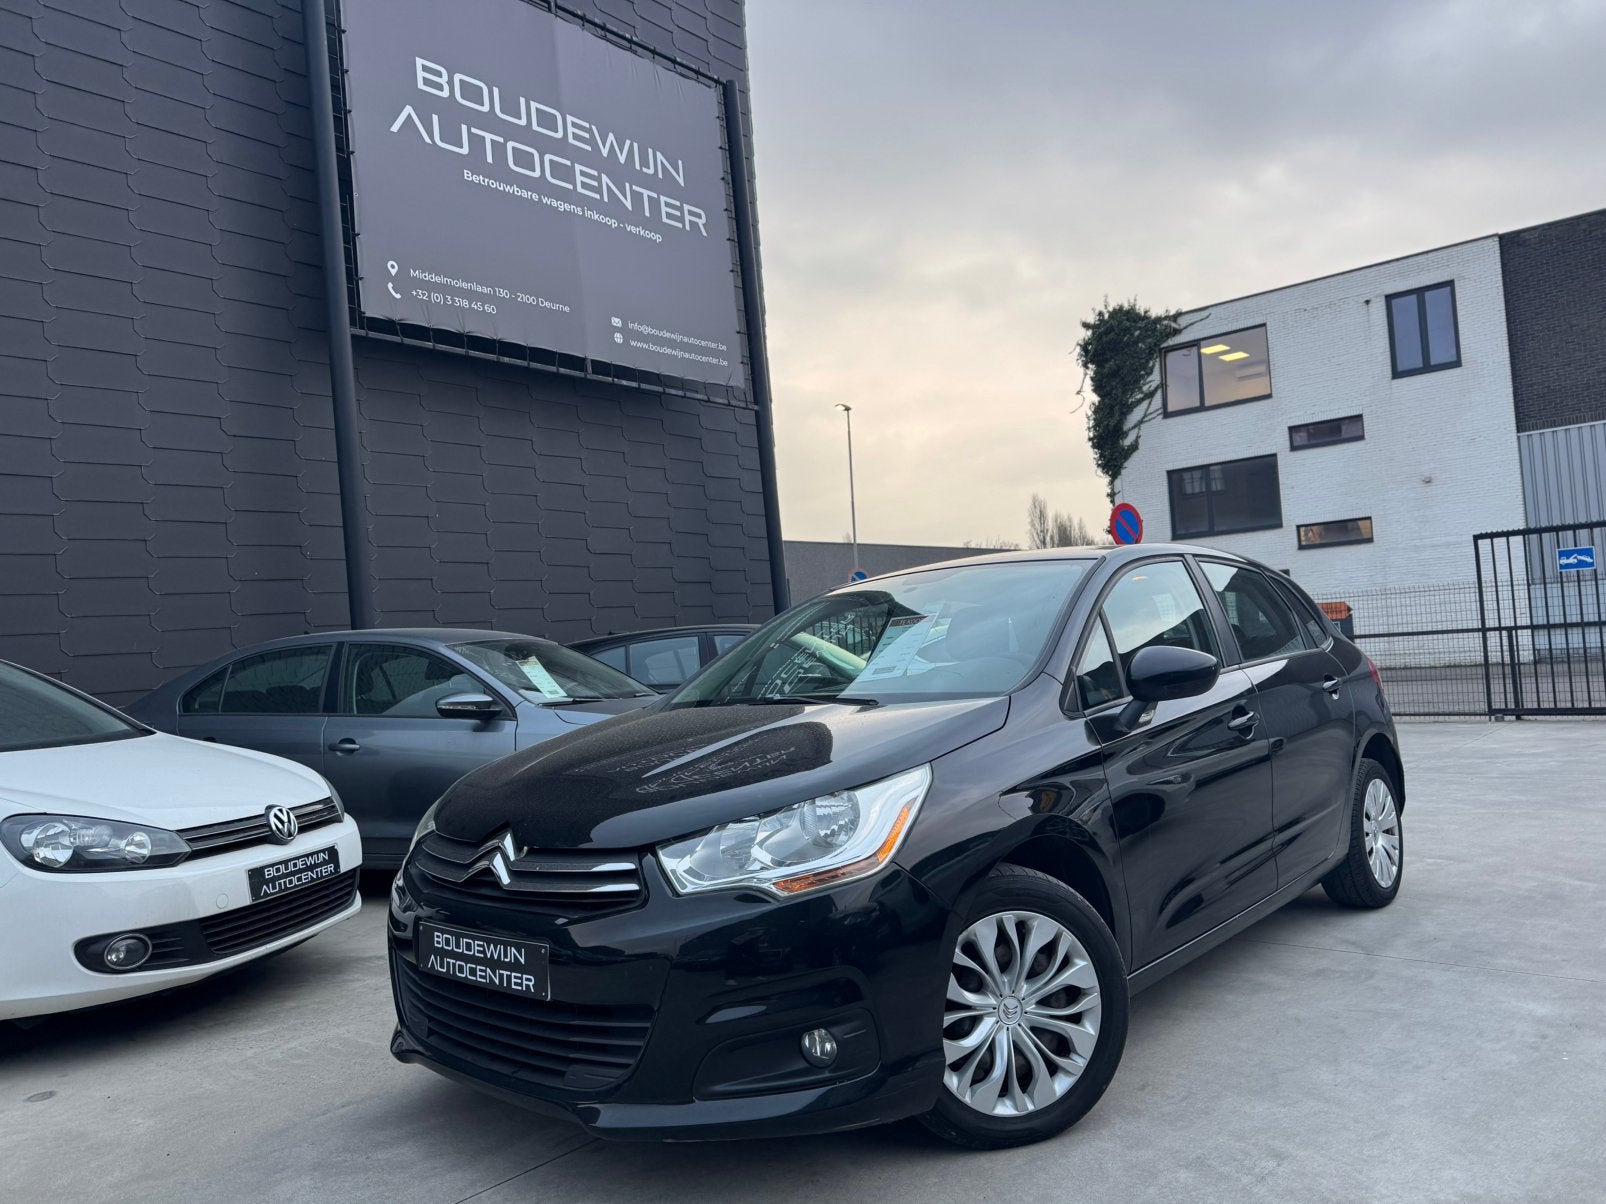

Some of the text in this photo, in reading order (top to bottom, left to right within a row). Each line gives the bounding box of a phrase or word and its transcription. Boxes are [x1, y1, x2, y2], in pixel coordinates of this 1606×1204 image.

[415, 56, 685, 188] BOUDEWIJN
[389, 104, 708, 237] AUTOCENTER
[463, 169, 539, 202] Betrouwbare
[541, 194, 583, 216] wagens
[584, 206, 618, 229] inkoop
[625, 222, 663, 244] verkoop
[410, 268, 494, 296] Middelmolenlaan
[495, 287, 510, 299] 130
[517, 293, 537, 306] 2100
[538, 298, 570, 313] Deurne
[411, 289, 497, 314] +32 (0) 3 318 45 60
[628, 321, 727, 351] info@boudewijnautocenter.be
[630, 339, 728, 367] www.boudewijnautocenter.be
[260, 863, 335, 896] AUTOCENTER
[264, 851, 329, 879] BOUDEWIJN
[434, 931, 525, 965] BOUDEWIJN
[428, 954, 535, 993] AUTOCENTER
